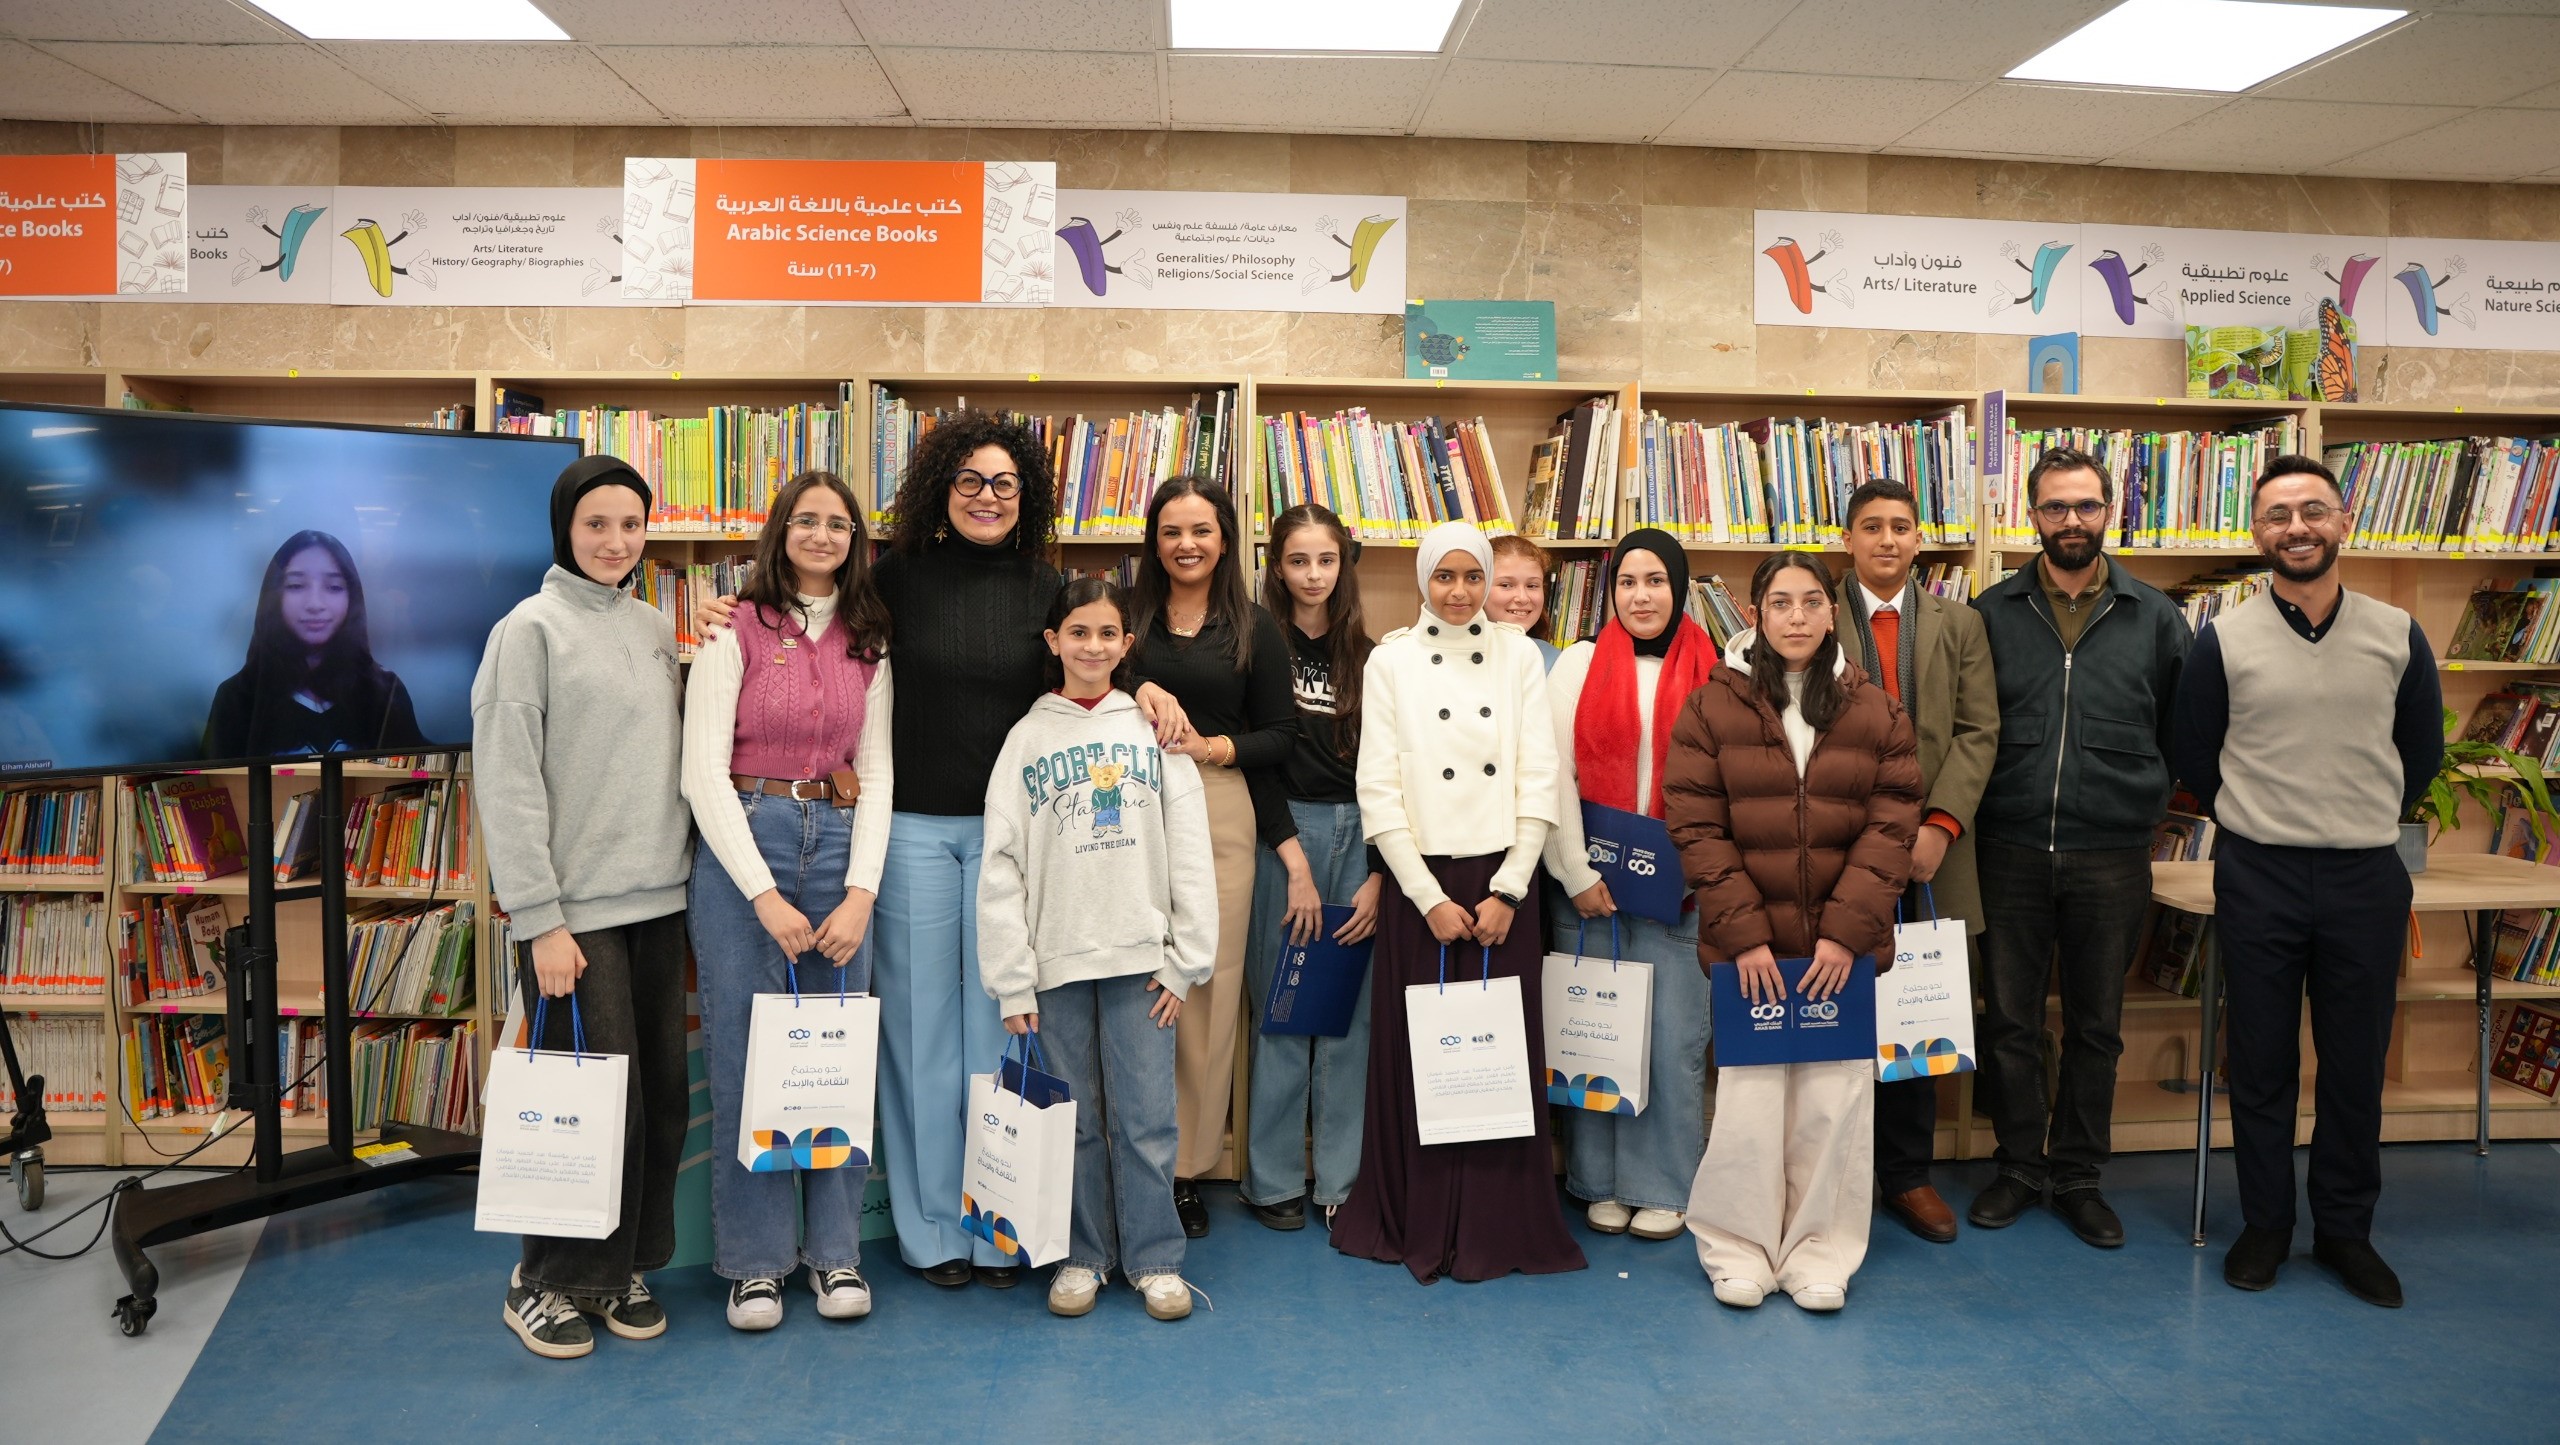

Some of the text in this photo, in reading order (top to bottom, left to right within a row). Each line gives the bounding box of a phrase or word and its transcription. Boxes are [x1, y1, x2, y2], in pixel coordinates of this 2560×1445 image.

[0, 192, 106, 212] كتب علمية
[716, 194, 962, 217] كتب علمية باللغة العربية
[542, 213, 565, 222] علوم
[22, 220, 83, 237] Books
[463, 225, 555, 235] تاريخ وجغرافيا وتراجم
[1152, 221, 1182, 231] ونفس
[1183, 221, 1203, 231] علم
[1205, 221, 1238, 231] فلسفة
[1268, 223, 1297, 233] معارف
[196, 228, 228, 241] كتب
[726, 223, 938, 243] Arabic Science Books
[1175, 233, 1215, 243] اجتماعية
[1216, 234, 1241, 243] علوم
[190, 248, 228, 260] Books
[473, 244, 544, 254] Arts/ Literature
[432, 257, 584, 268] History/ Geography/ Biographies
[1156, 253, 1295, 267] Generalities/ Philosophy
[1921, 254, 1962, 270] فنون
[787, 260, 824, 277] سنة
[2182, 263, 2289, 283] علوم تطبيقية
[1251, 270, 1294, 281] Science
[1863, 276, 1977, 294] Arts/ Literature
[2486, 275, 2544, 294] طبيعية
[2181, 289, 2291, 306] Applied Science
[2485, 298, 2532, 312] Nature
[1275, 424, 1286, 473] MAGIC TRICKS
[24, 761, 50, 769] Alsharif
[1022, 742, 1105, 816] SPORT
[190, 794, 227, 811] Rubber
[1075, 838, 1136, 854] LIVING THE DREAM
[195, 911, 220, 926] Human
[201, 925, 221, 936] Body
[1924, 992, 1950, 1001] الثقافة
[1590, 1030, 1618, 1042] الثقافة
[817, 1076, 849, 1086] الثقافة
